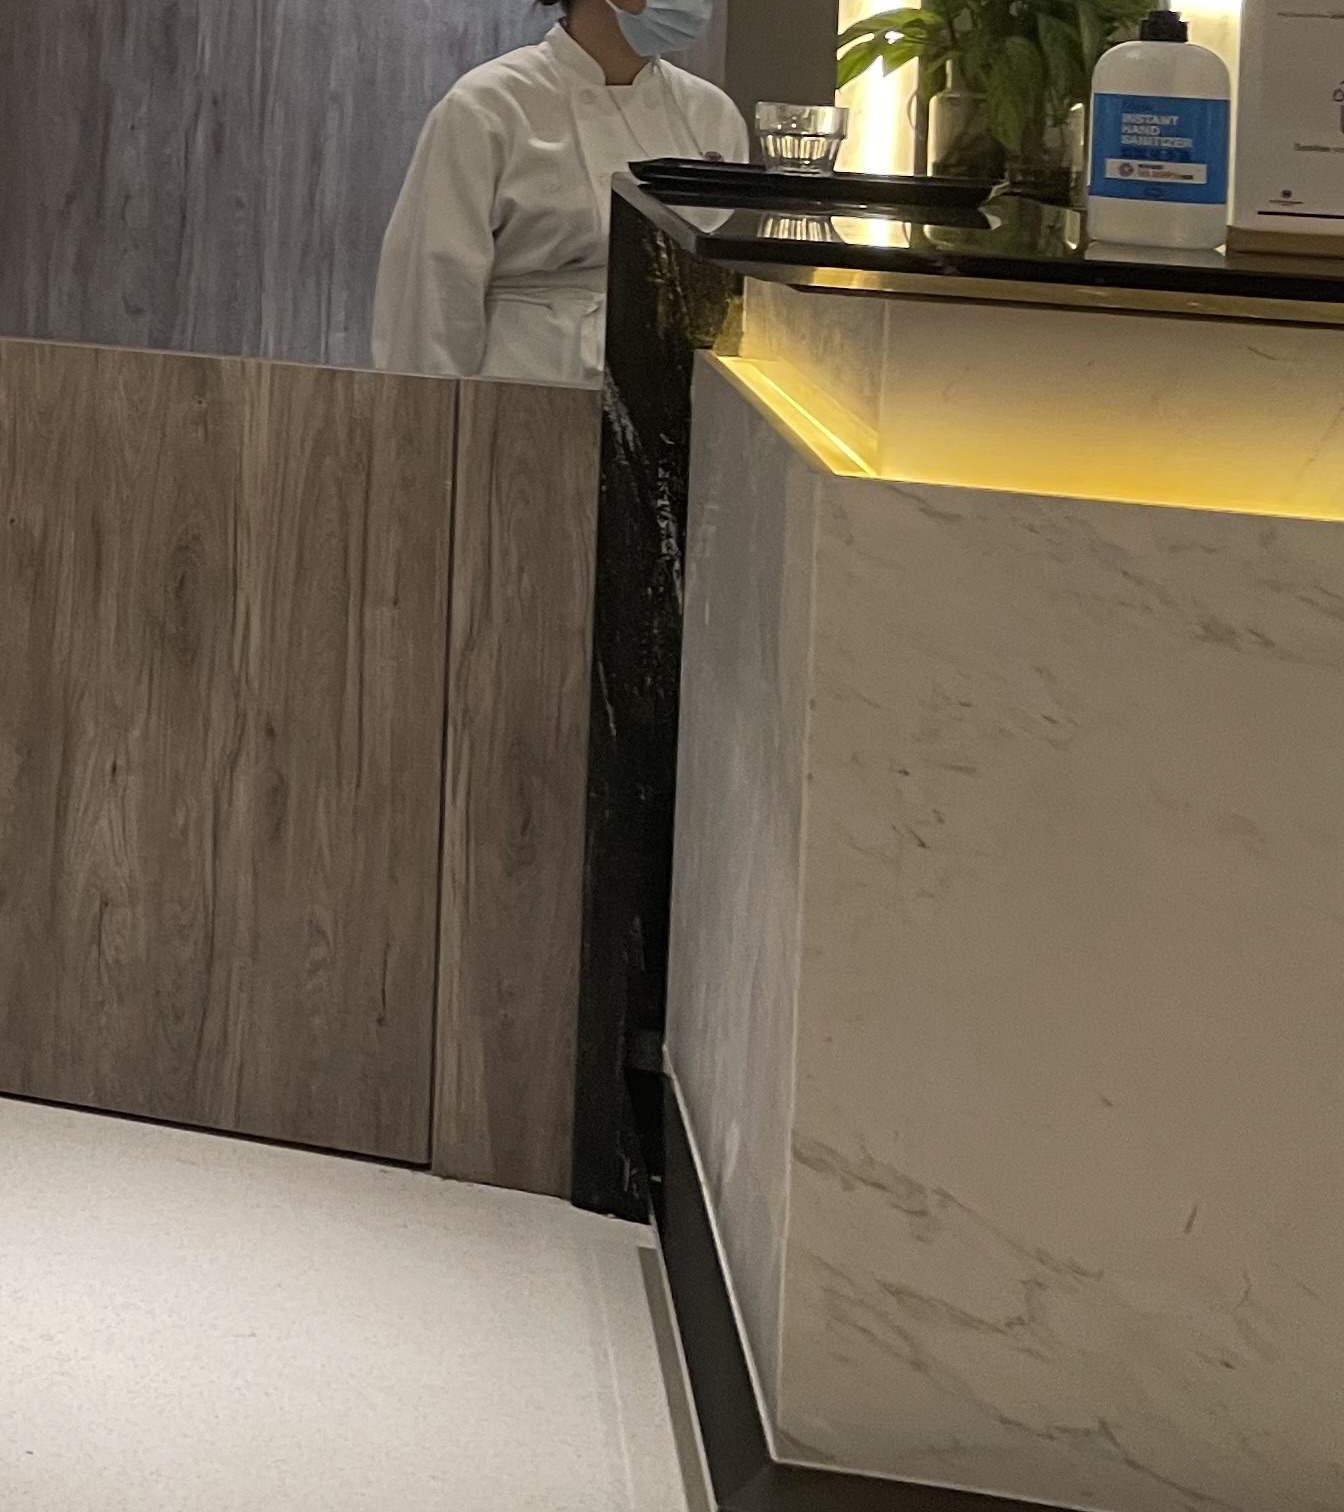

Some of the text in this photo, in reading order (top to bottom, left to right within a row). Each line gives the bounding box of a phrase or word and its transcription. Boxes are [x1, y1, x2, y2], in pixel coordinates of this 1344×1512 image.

[1121, 112, 1179, 126] INSTANT
[1121, 124, 1161, 136] HAND
[1120, 134, 1193, 149] SANITIZER
